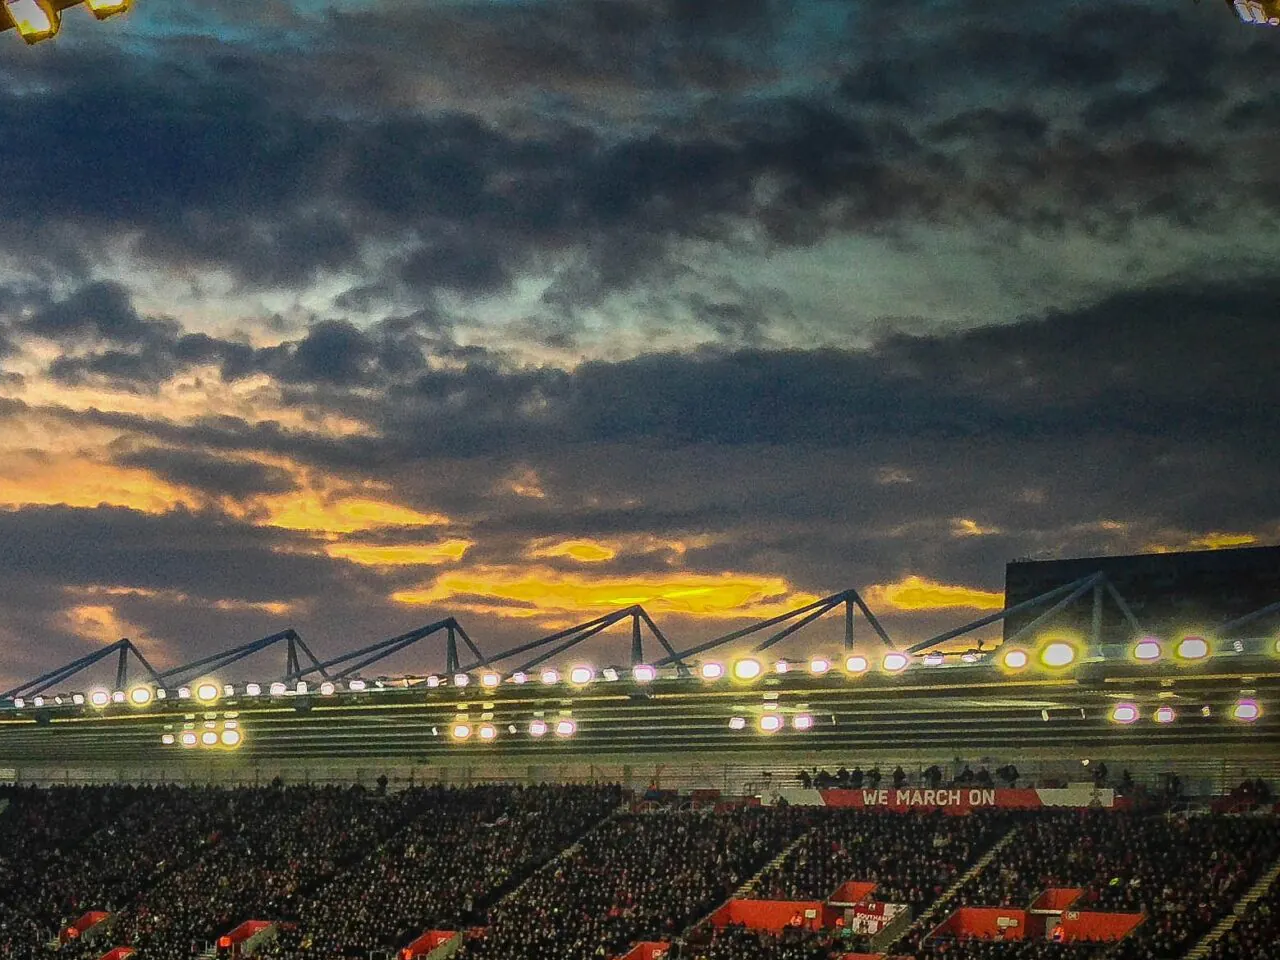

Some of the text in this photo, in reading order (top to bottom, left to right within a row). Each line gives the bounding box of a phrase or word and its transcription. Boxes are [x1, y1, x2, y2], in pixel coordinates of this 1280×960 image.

[862, 789, 996, 806] WE MARCH ON
